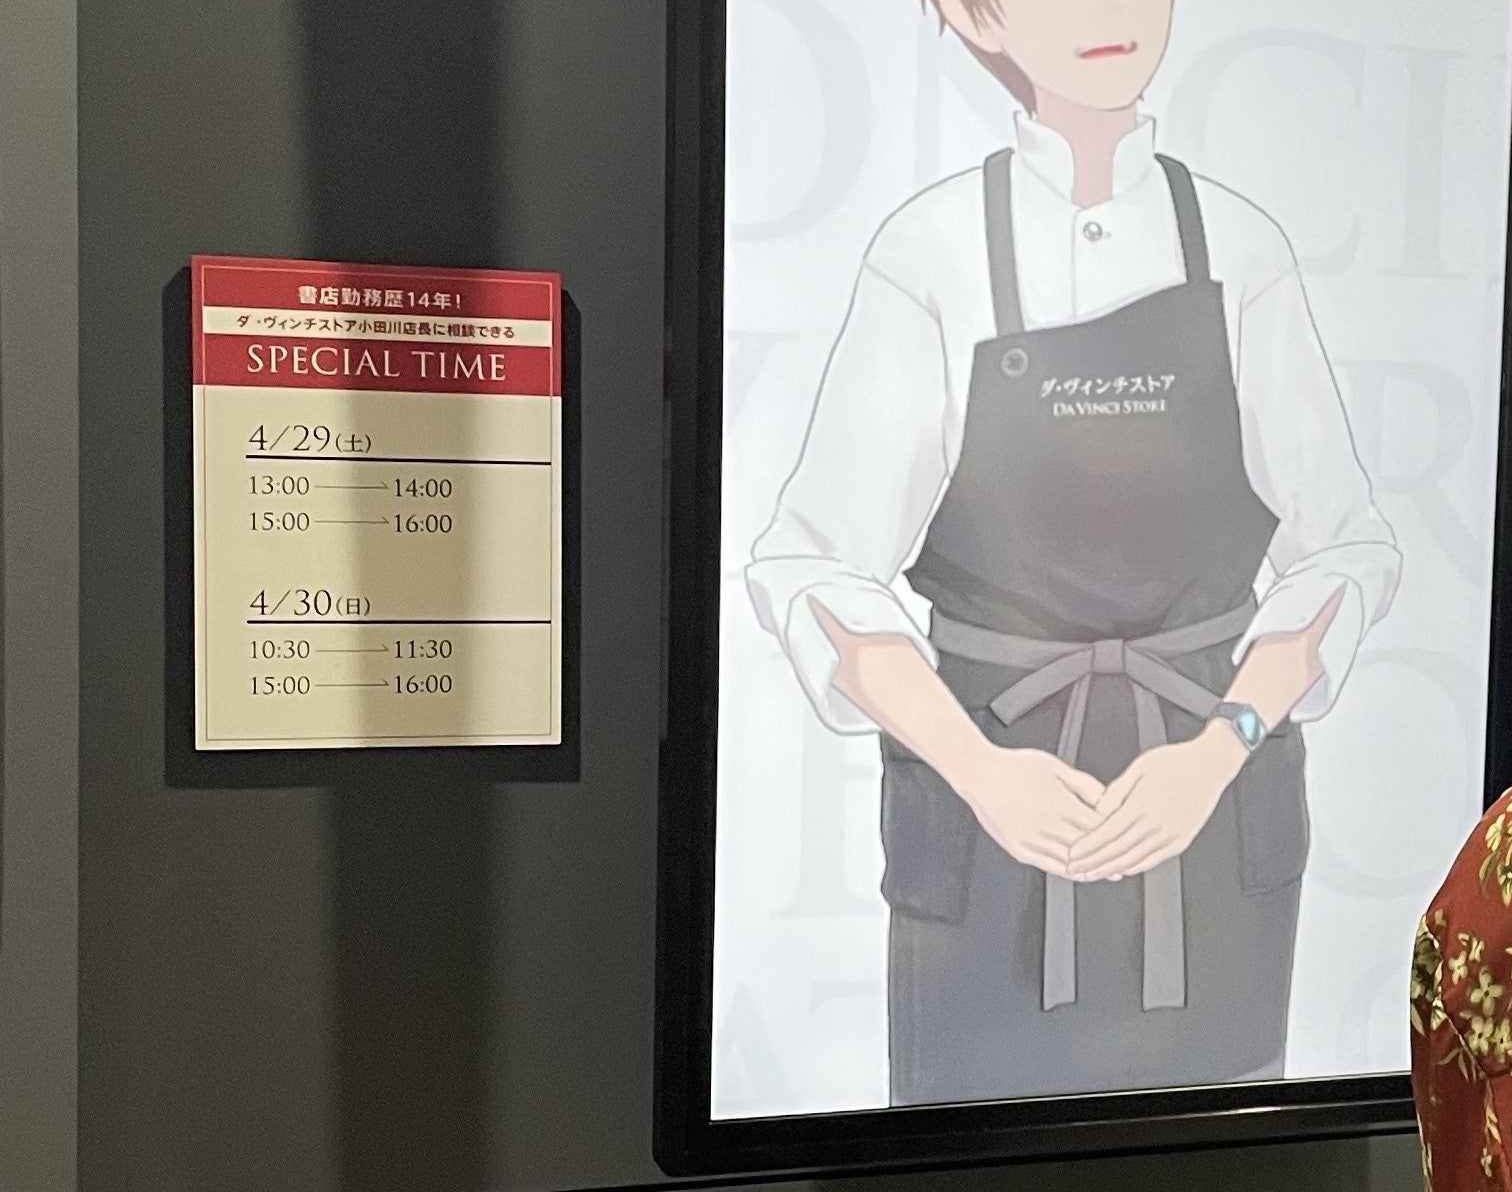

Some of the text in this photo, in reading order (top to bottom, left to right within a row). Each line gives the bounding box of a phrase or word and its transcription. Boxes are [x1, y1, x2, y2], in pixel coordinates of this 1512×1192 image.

[298, 285, 462, 310] 書店勤務歴14年!
[247, 343, 507, 381] SPECIAL TIME
[249, 476, 453, 499] 13:00 14:00
[250, 512, 453, 534] 15:00 16:00
[250, 640, 453, 661] 10:30 11:30
[251, 675, 453, 696] 15:00 16:00
